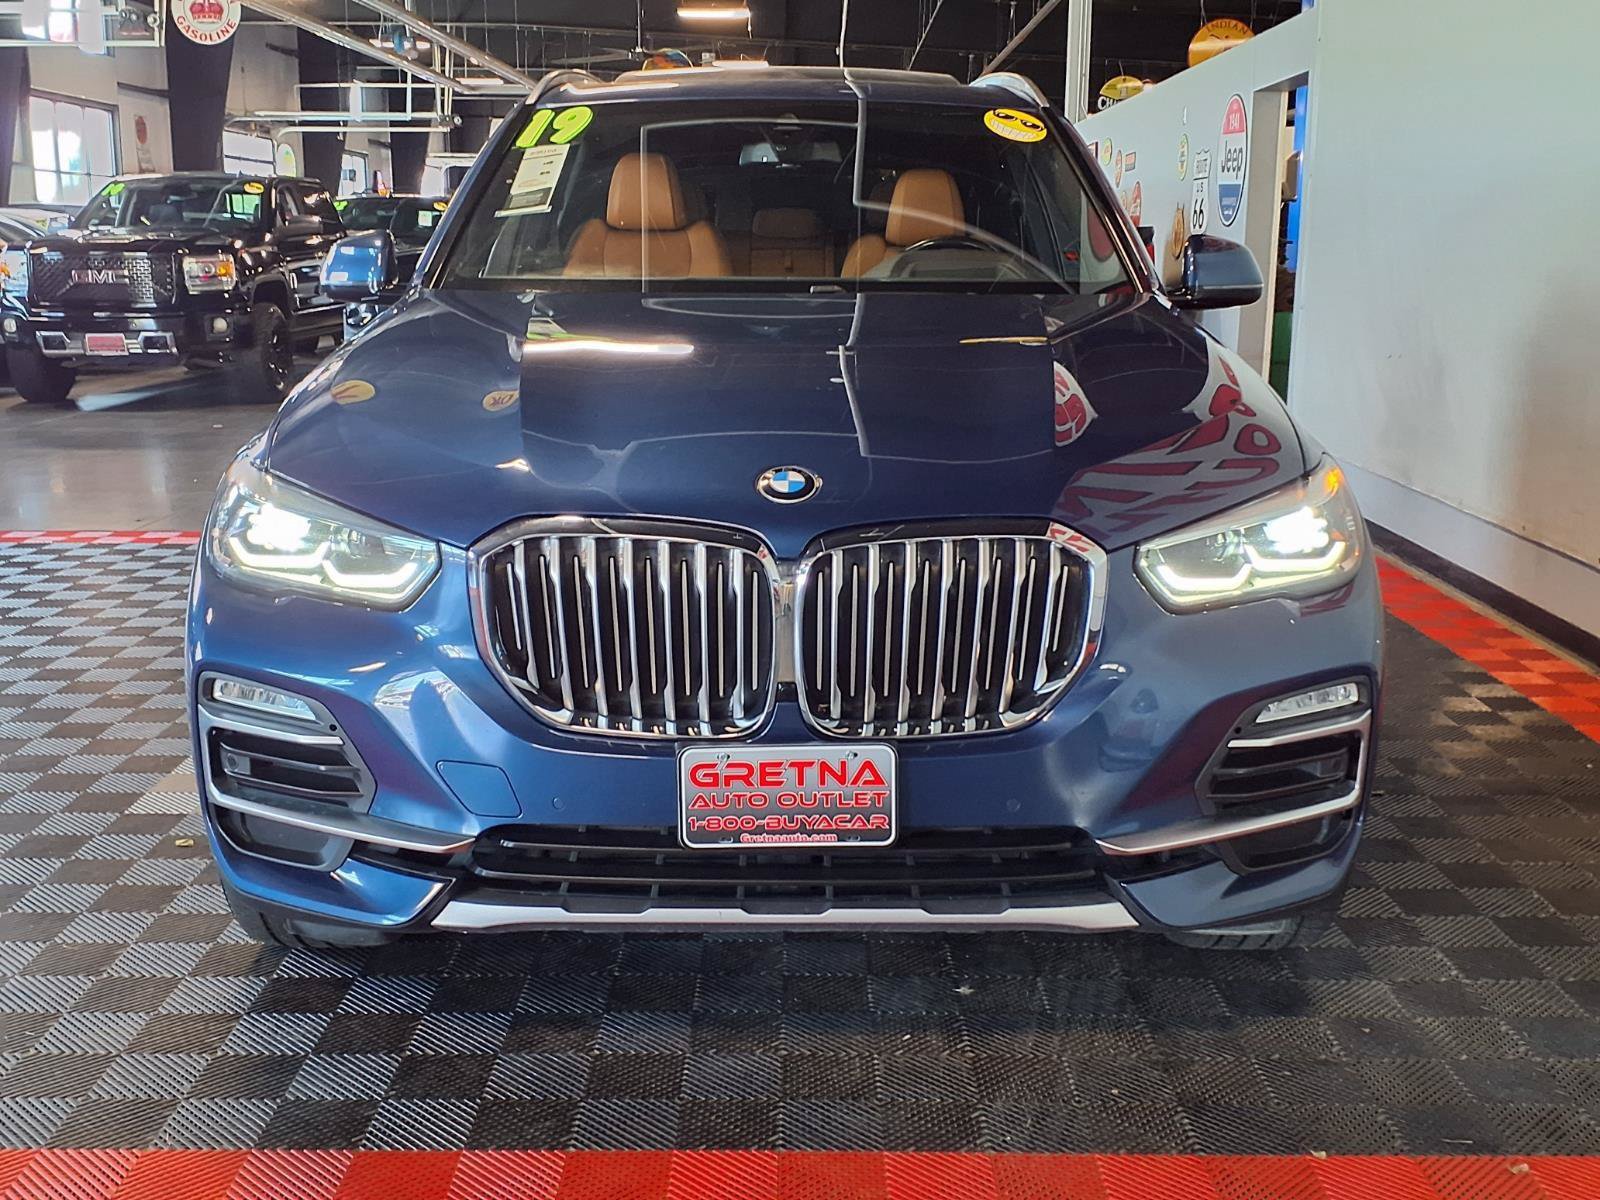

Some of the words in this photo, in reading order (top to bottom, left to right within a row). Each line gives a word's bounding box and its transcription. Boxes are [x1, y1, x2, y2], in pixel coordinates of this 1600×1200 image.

[177, 15, 236, 42] GASOLINE
[1206, 20, 1248, 35] INDIAN
[515, 106, 594, 148] 19
[1221, 140, 1244, 180] Jeep
[1192, 198, 1205, 229] 66
[71, 269, 129, 285] GMC
[689, 758, 888, 788] GRETNA
[688, 792, 769, 810] AUTO
[776, 790, 890, 808] OUTLET
[688, 814, 890, 831] 1-800-BUYACAR
[740, 832, 837, 842] Gretnaauto.com
